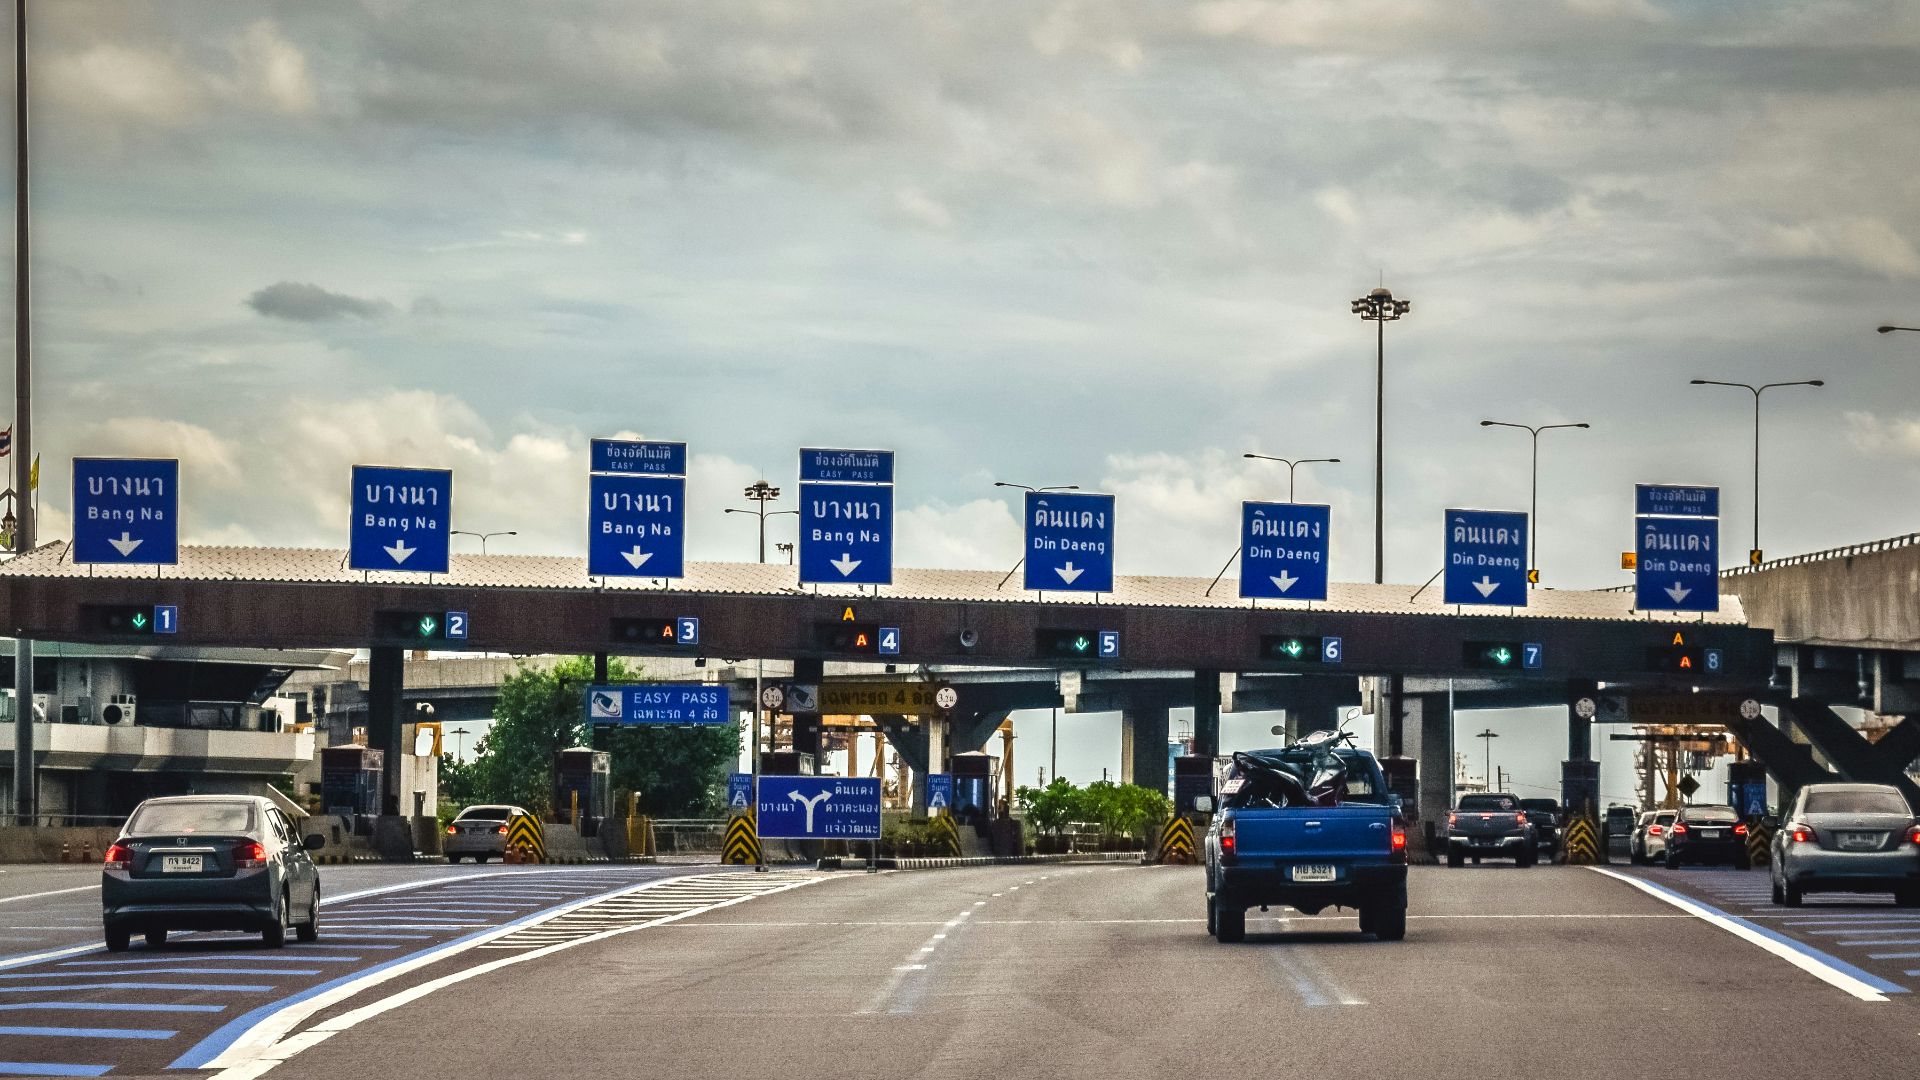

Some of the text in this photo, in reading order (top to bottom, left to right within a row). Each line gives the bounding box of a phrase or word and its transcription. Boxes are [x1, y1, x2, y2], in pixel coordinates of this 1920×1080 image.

[611, 461, 666, 471] EASY PASS
[820, 470, 874, 479] EASY PASS
[86, 476, 163, 496] บางนา
[366, 484, 438, 506] บางนา
[603, 492, 672, 512] บางนา
[813, 500, 880, 520] บางนา
[87, 506, 163, 524] Bang Na
[365, 513, 437, 532] Bang Na
[1035, 500, 1105, 529] ดินแดง
[602, 521, 671, 538] Bang Na
[1251, 510, 1320, 538] ดินแดง
[1454, 517, 1520, 545] ดินแดง
[812, 528, 880, 545] Bang Na
[1034, 536, 1105, 555] Din Daeng
[1645, 525, 1710, 551] ดินแดง
[1250, 545, 1320, 564] Din Daeng
[1452, 552, 1520, 570] Din Daeng
[1644, 557, 1711, 576] Din Daeng
[162, 609, 170, 629] 1
[842, 607, 855, 621] A
[450, 616, 463, 635] 2
[662, 625, 673, 637] A
[681, 621, 695, 640] 3
[856, 634, 867, 646] A
[882, 632, 897, 650] 4
[1103, 635, 1116, 653] 5
[1672, 632, 1684, 646] A
[1325, 641, 1338, 659] 6
[1526, 647, 1538, 665] 7
[1680, 656, 1691, 668] A
[1708, 652, 1719, 669] 8
[633, 692, 718, 704] EASY PASS
[894, 689, 906, 706] 4
[633, 706, 719, 720] เฉพาะรถ 4 ล้อ
[835, 781, 874, 796] ดินแดง
[761, 802, 795, 812] บางนา
[825, 802, 879, 813] ดาวคะนอง
